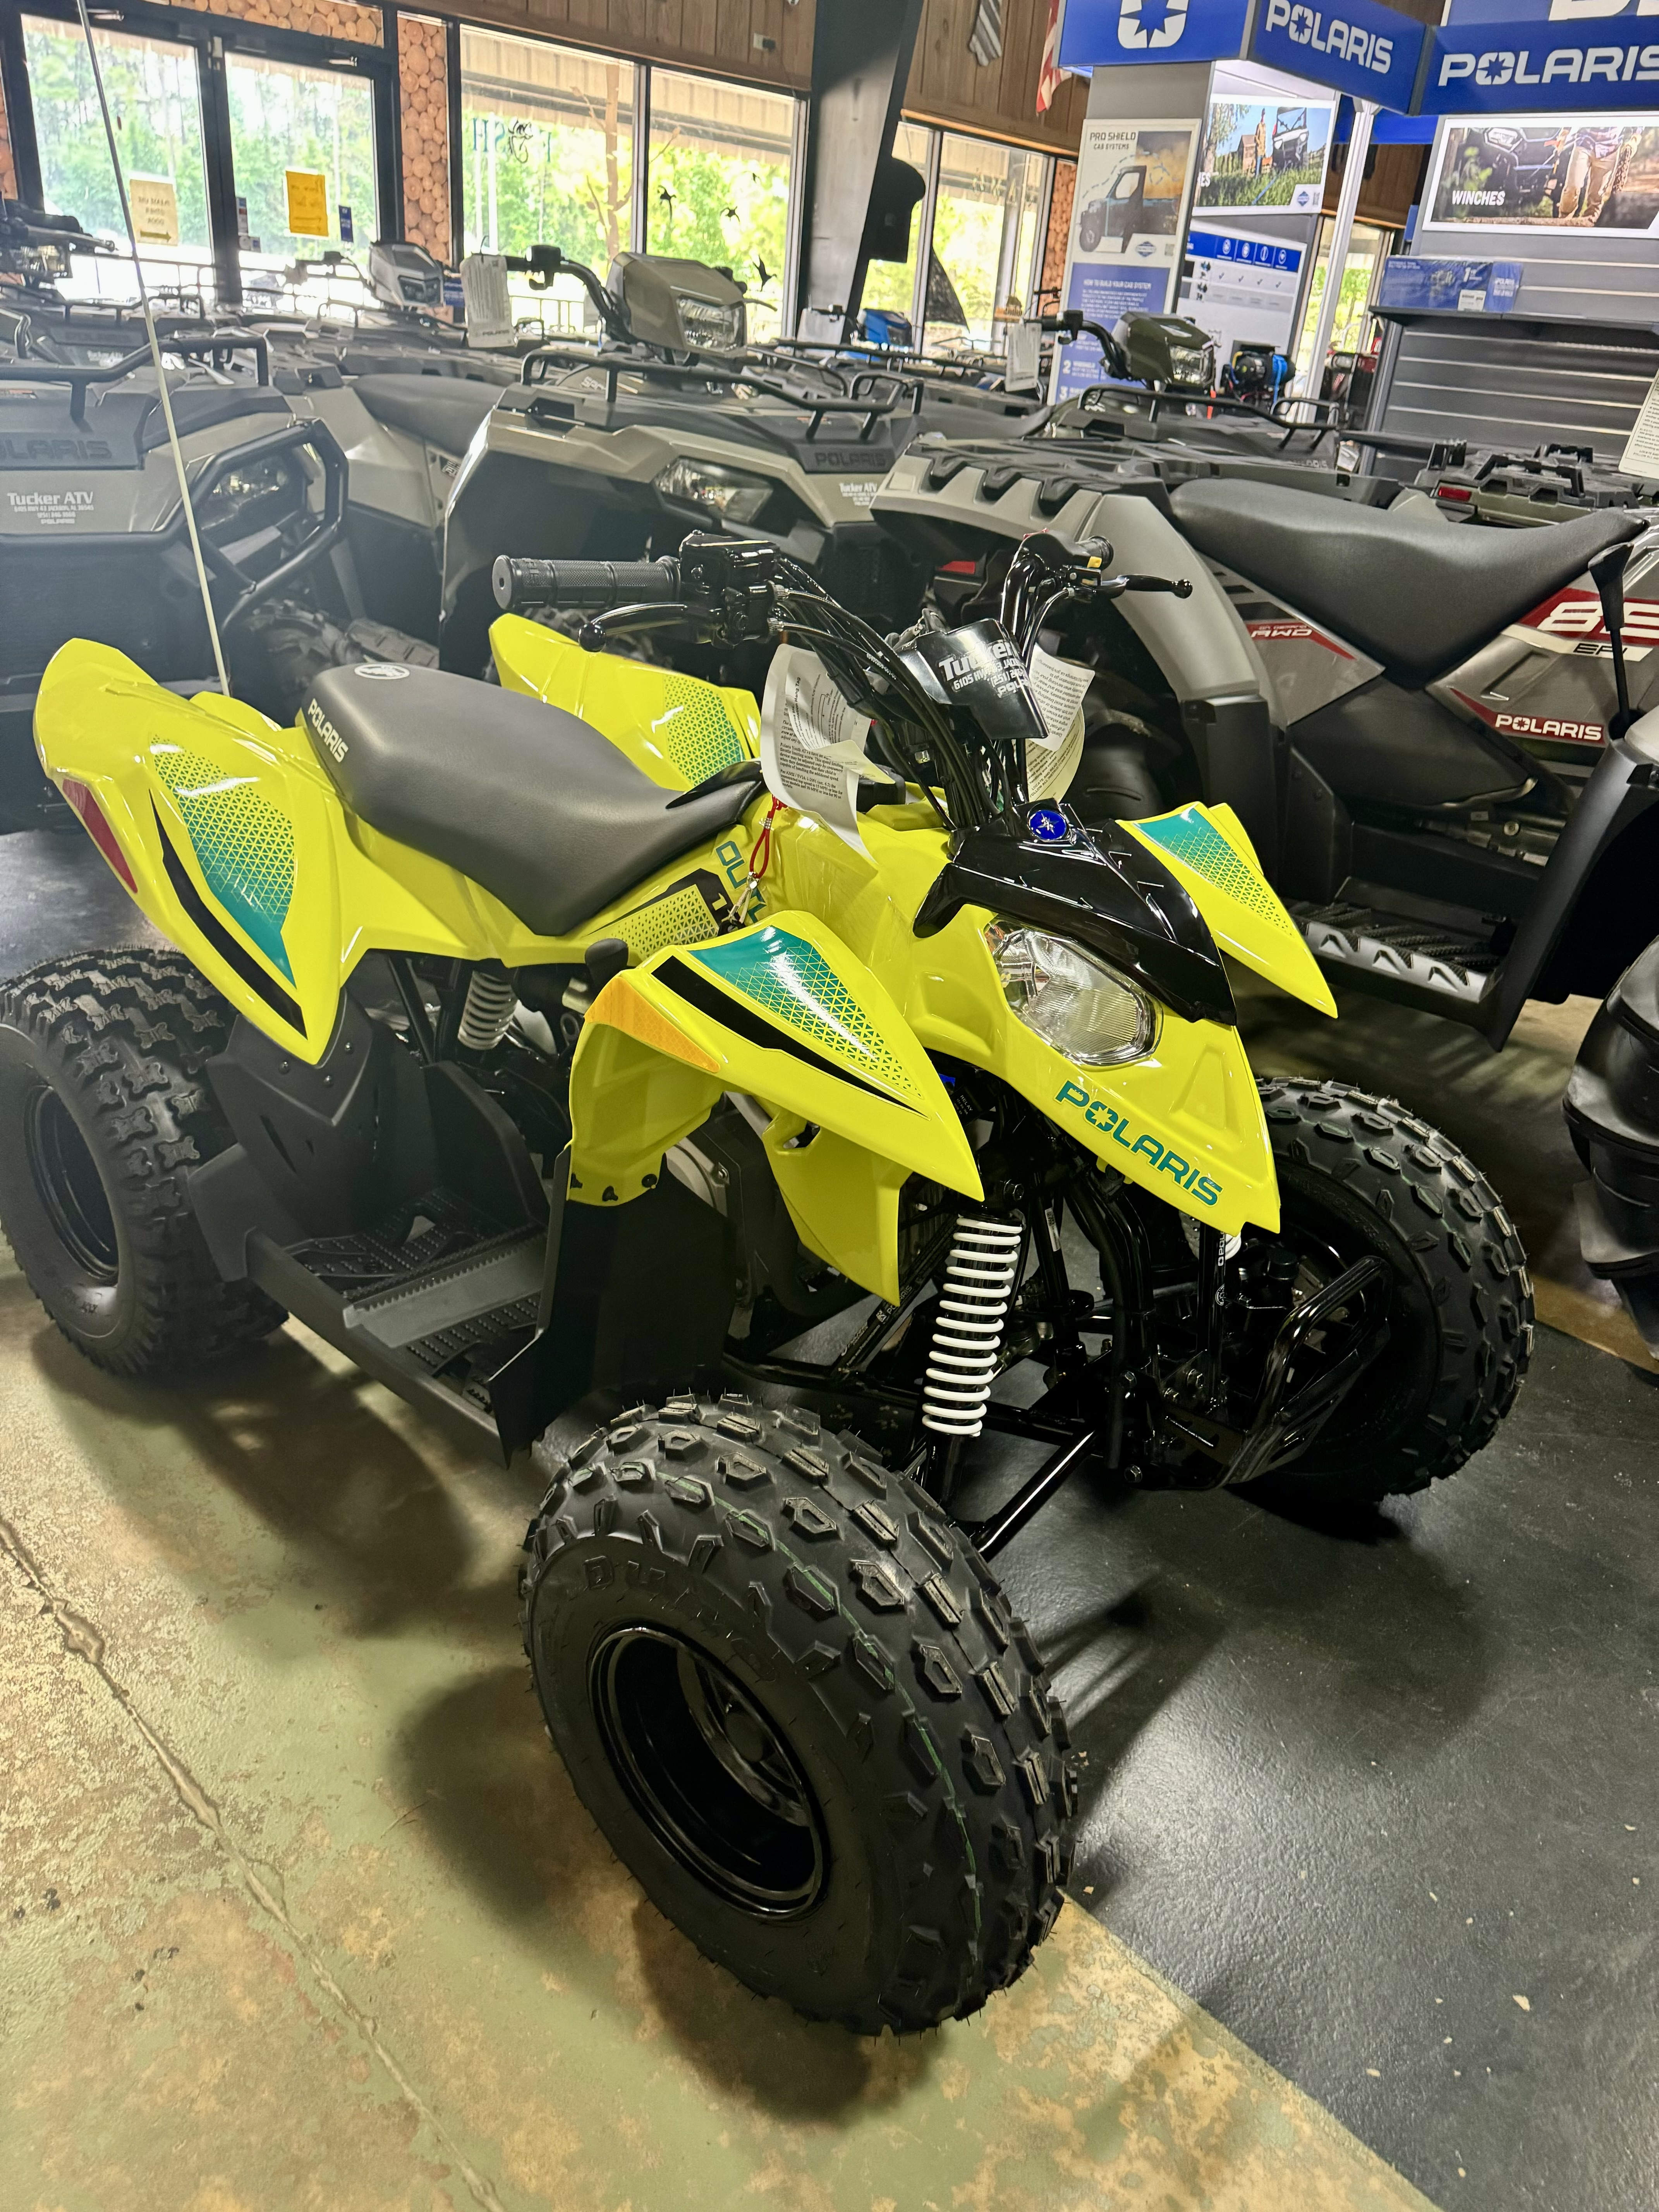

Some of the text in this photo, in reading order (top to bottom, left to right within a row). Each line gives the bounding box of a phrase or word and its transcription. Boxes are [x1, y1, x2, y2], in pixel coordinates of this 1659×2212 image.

[1266, 0, 1393, 74] POLARIS
[1438, 45, 1659, 87] POLARIS
[1089, 132, 1136, 141] PRO SHIELD
[1452, 190, 1506, 206] WINCHES
[1063, 360, 1071, 374] 2
[0, 440, 112, 459] LARIS
[814, 452, 886, 465] POLARIS
[7, 491, 93, 505] Tucker ATV
[1251, 629, 1312, 638] AWD
[1573, 643, 1628, 656] EFI
[953, 674, 974, 690] 6105
[990, 671, 1010, 687] (251)
[308, 698, 349, 763] POLARIS
[1495, 714, 1602, 741] POLARIS
[1031, 778, 1044, 790] LOCATE
[1054, 1079, 1223, 1206] POLARIS
